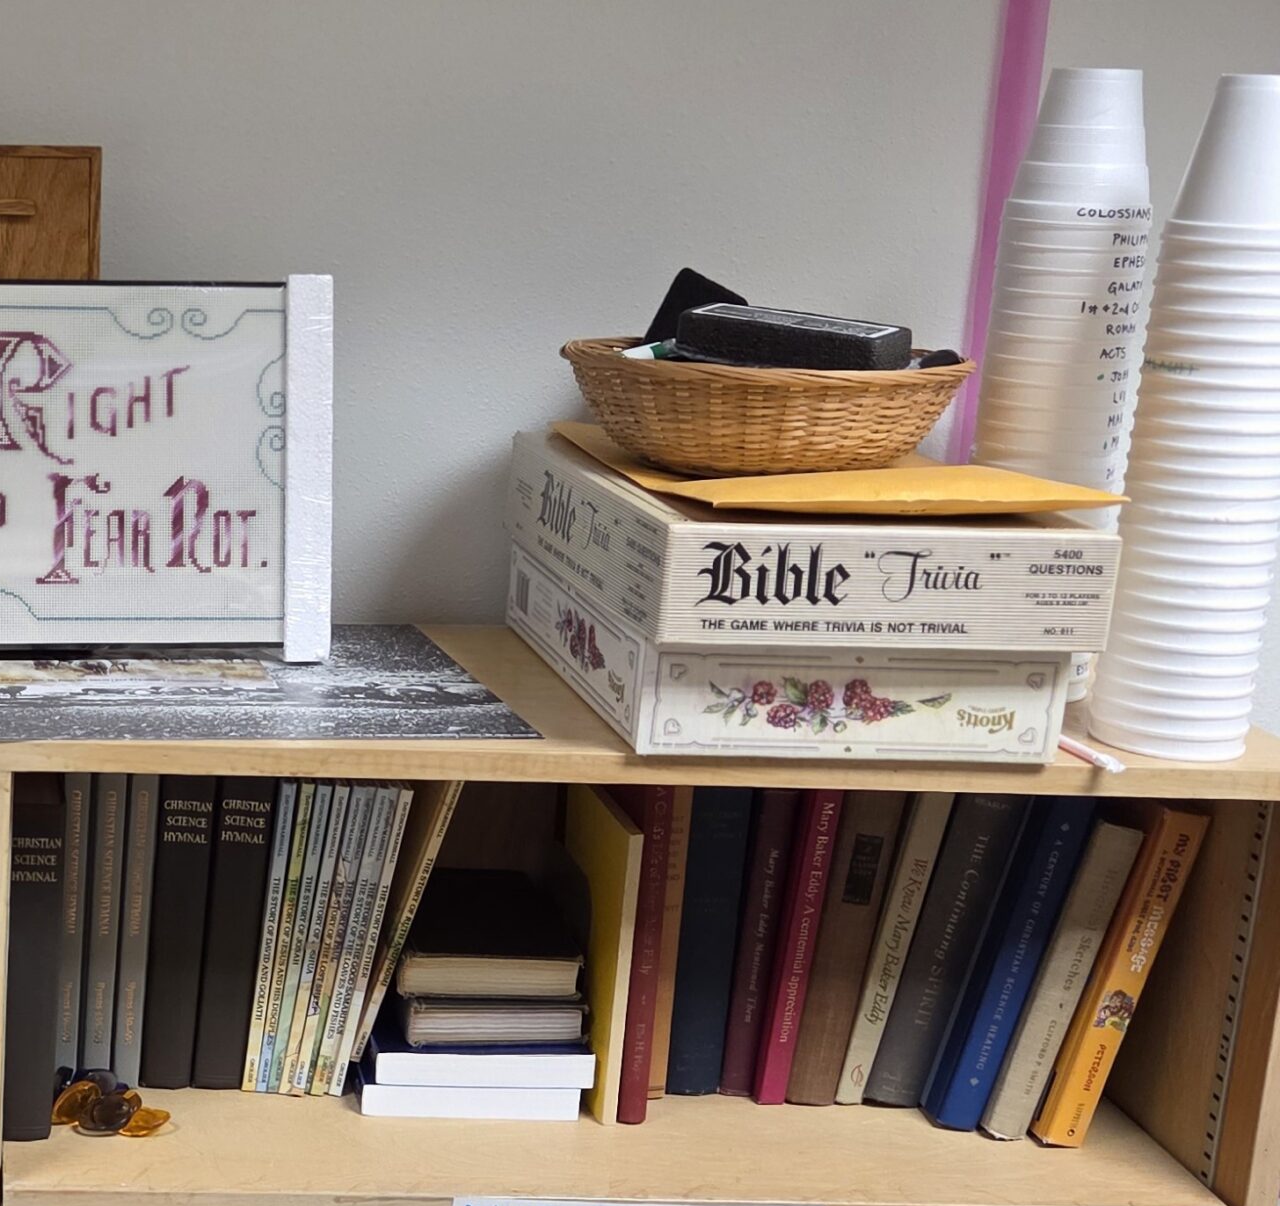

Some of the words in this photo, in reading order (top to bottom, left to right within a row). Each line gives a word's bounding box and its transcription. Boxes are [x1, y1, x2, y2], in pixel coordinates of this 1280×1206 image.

[1077, 207, 1151, 221] COLOSSIANS
[1100, 347, 1127, 359] ACTS
[36, 472, 155, 584] FEAR
[1053, 550, 1083, 560] 5400
[694, 541, 851, 608] Bible
[1028, 564, 1104, 576] QUESTIONS
[701, 619, 725, 630] THE
[730, 620, 767, 631] GAME
[773, 620, 818, 632] WHERE
[825, 622, 866, 633] TRIVIA
[870, 622, 882, 633] IS
[888, 623, 915, 634] NOT
[920, 623, 968, 635] TRIVIAL
[164, 800, 214, 812] CHRISTIAN
[222, 799, 272, 813] CHRISTIAN
[816, 802, 835, 832] Mary
[166, 816, 208, 829] SCIENCE
[224, 816, 266, 829] SCIENCE
[163, 831, 208, 844] HYMNAL
[221, 831, 266, 845] HYMNAL
[971, 835, 991, 863] THE
[1054, 840, 1064, 848] A
[14, 855, 57, 866] SCIENCE
[812, 837, 829, 867] Baker
[11, 871, 57, 883] HYMNAL
[911, 857, 929, 879] We
[1039, 850, 1059, 897] CENTURY
[803, 905, 815, 914] A
[900, 878, 922, 914] Knew
[1030, 901, 1042, 915] OF
[934, 871, 980, 961] Continuing
[793, 919, 812, 973] centennial
[886, 914, 911, 951] Mary
[1012, 919, 1035, 973] CHRISTIAN
[878, 953, 899, 990] Baker
[1063, 935, 1092, 992] Sketches
[779, 976, 799, 1042] appreciation
[864, 990, 889, 1026] Eddy
[992, 977, 1014, 1020] SCIENCE
[976, 1024, 999, 1070] HEALING
[1083, 1043, 1107, 1092] PETERSON
